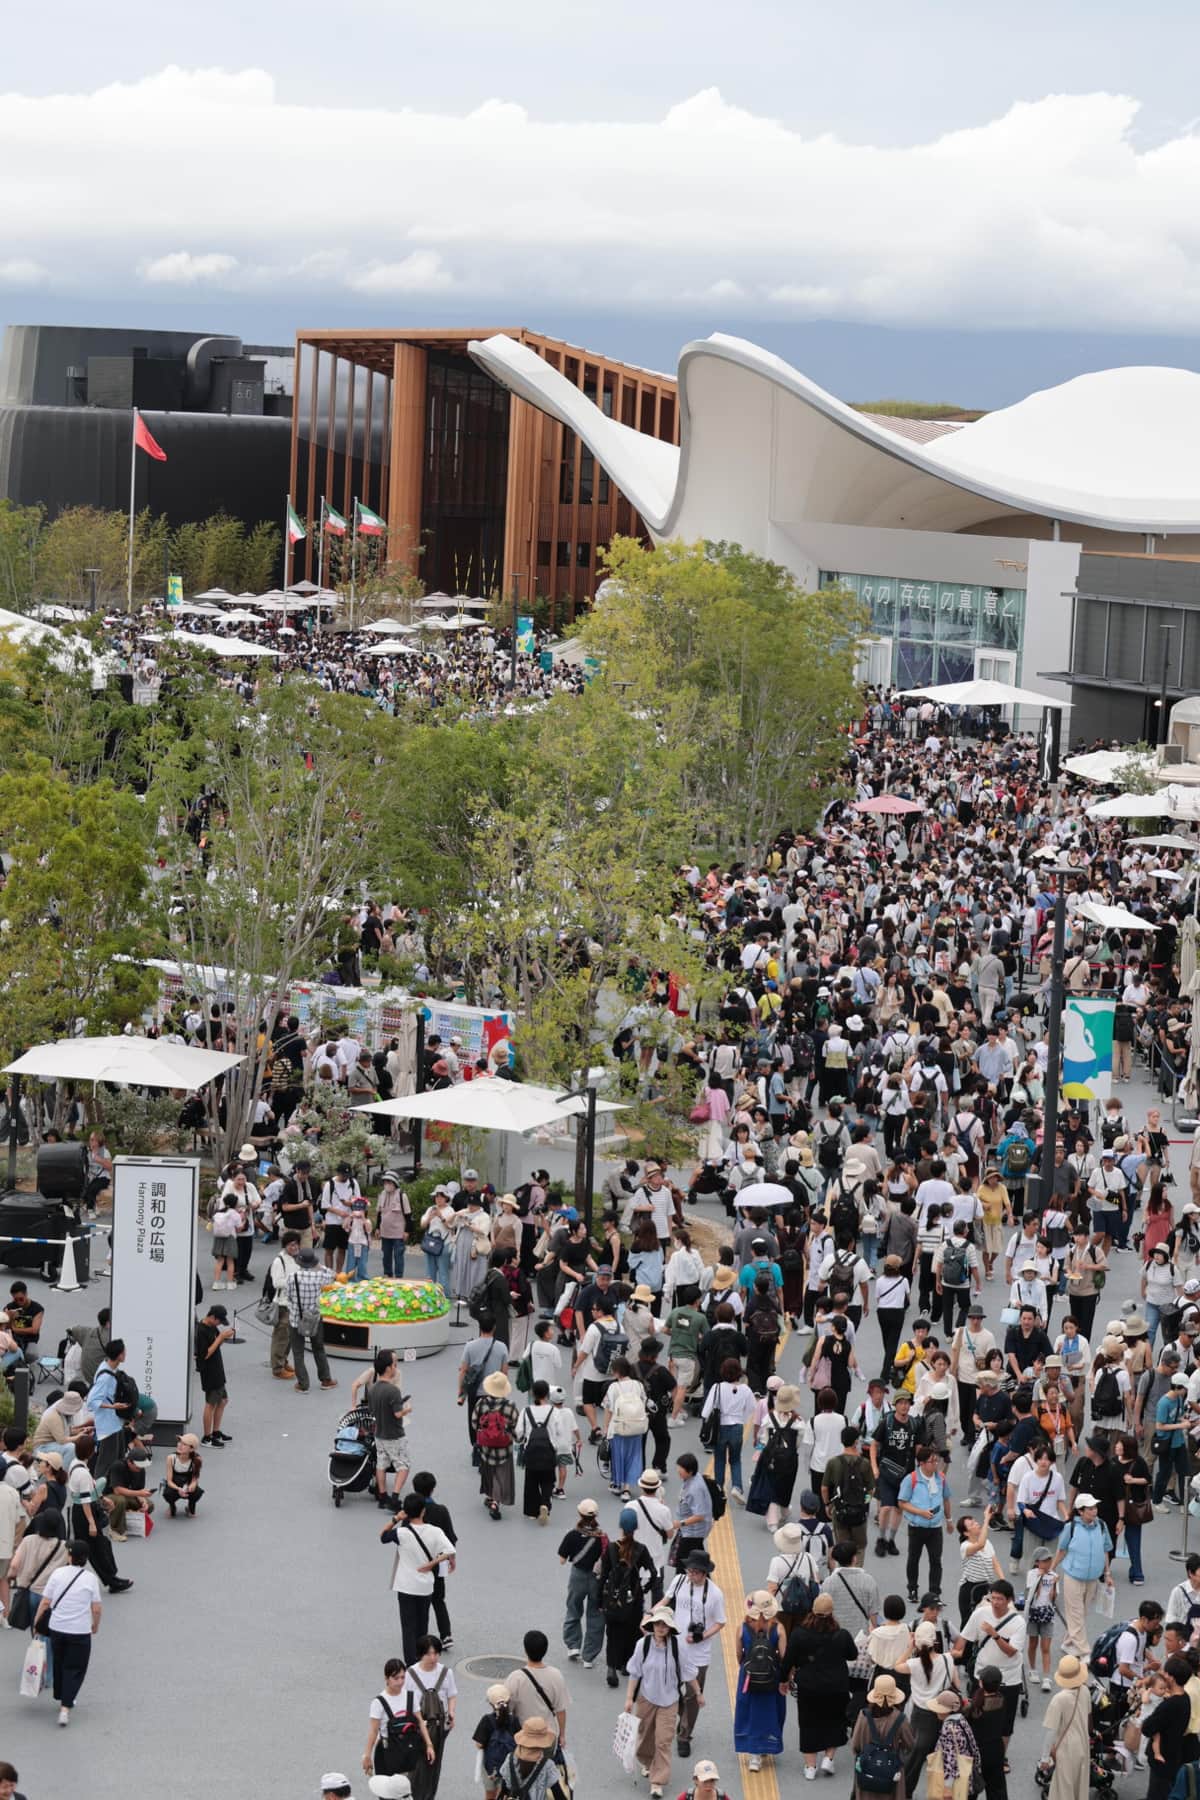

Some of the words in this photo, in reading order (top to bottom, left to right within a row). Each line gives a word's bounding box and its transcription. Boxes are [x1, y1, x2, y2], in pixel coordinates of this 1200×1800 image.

[136, 1182, 147, 1226] Harmony
[150, 1182, 166, 1263] 調和の広場
[137, 1228, 146, 1253] Plaza
